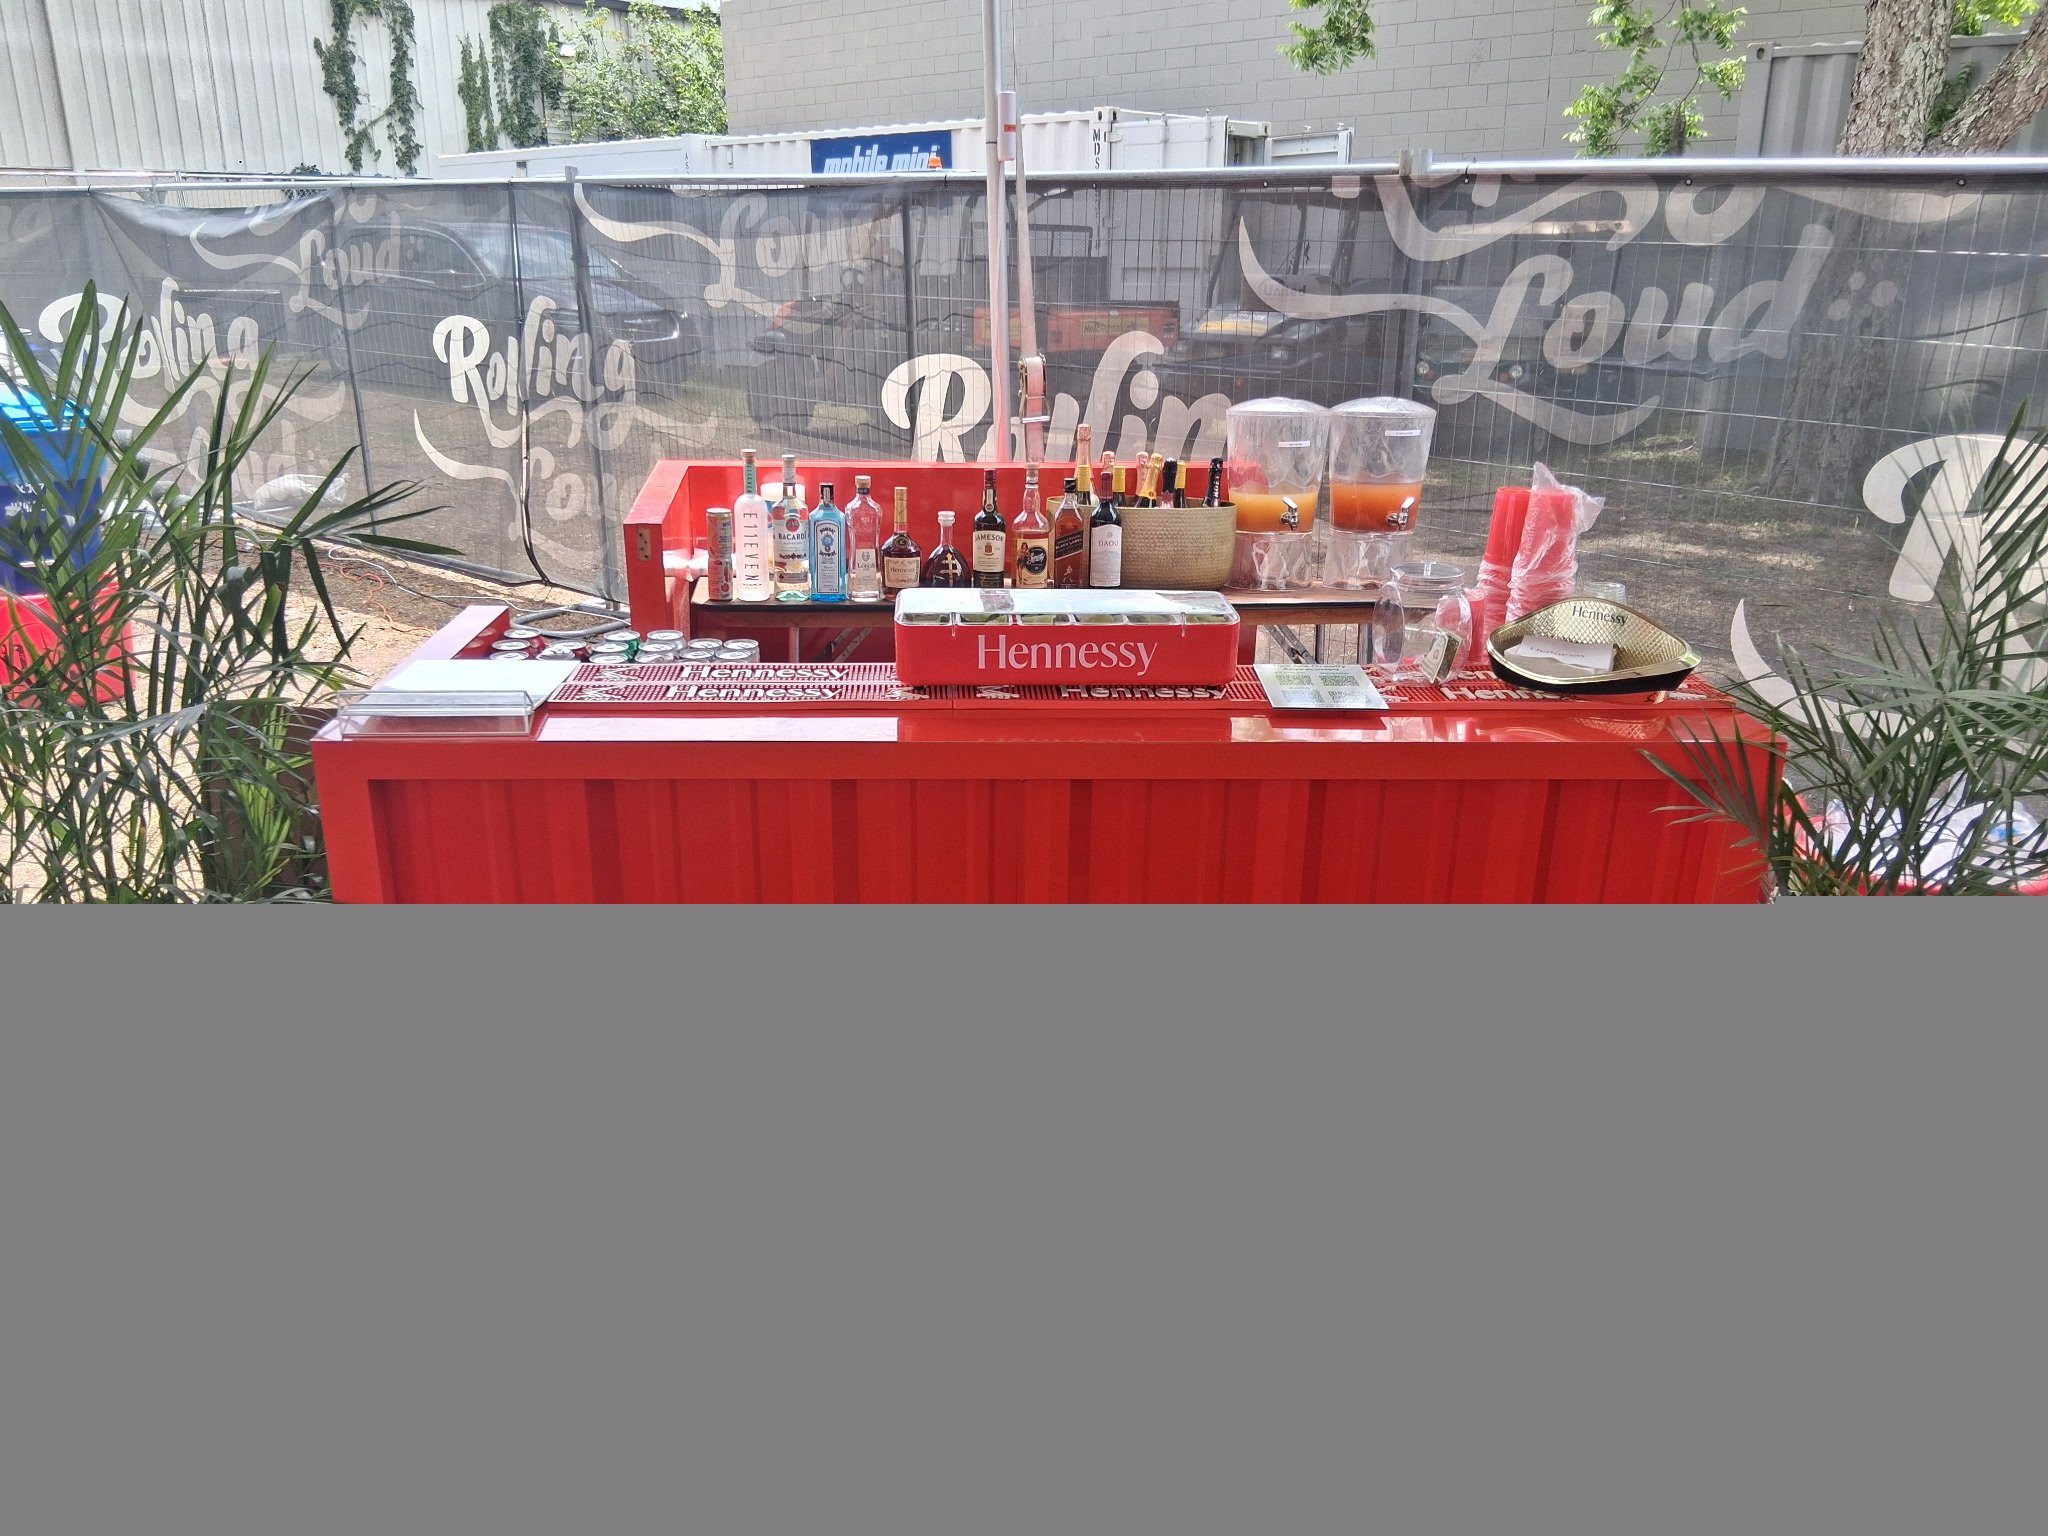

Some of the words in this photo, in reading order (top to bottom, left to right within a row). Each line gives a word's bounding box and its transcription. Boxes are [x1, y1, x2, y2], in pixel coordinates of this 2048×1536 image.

[1432, 224, 1834, 445] Loud
[433, 296, 638, 450] Rolling
[974, 533, 1005, 542] JAMESON
[1572, 604, 1629, 626] Hennessy
[978, 634, 1158, 676] Hennessy
[681, 664, 851, 681] Hennessy
[666, 685, 843, 700] Hennessy
[1060, 685, 1228, 700] Hennessy
